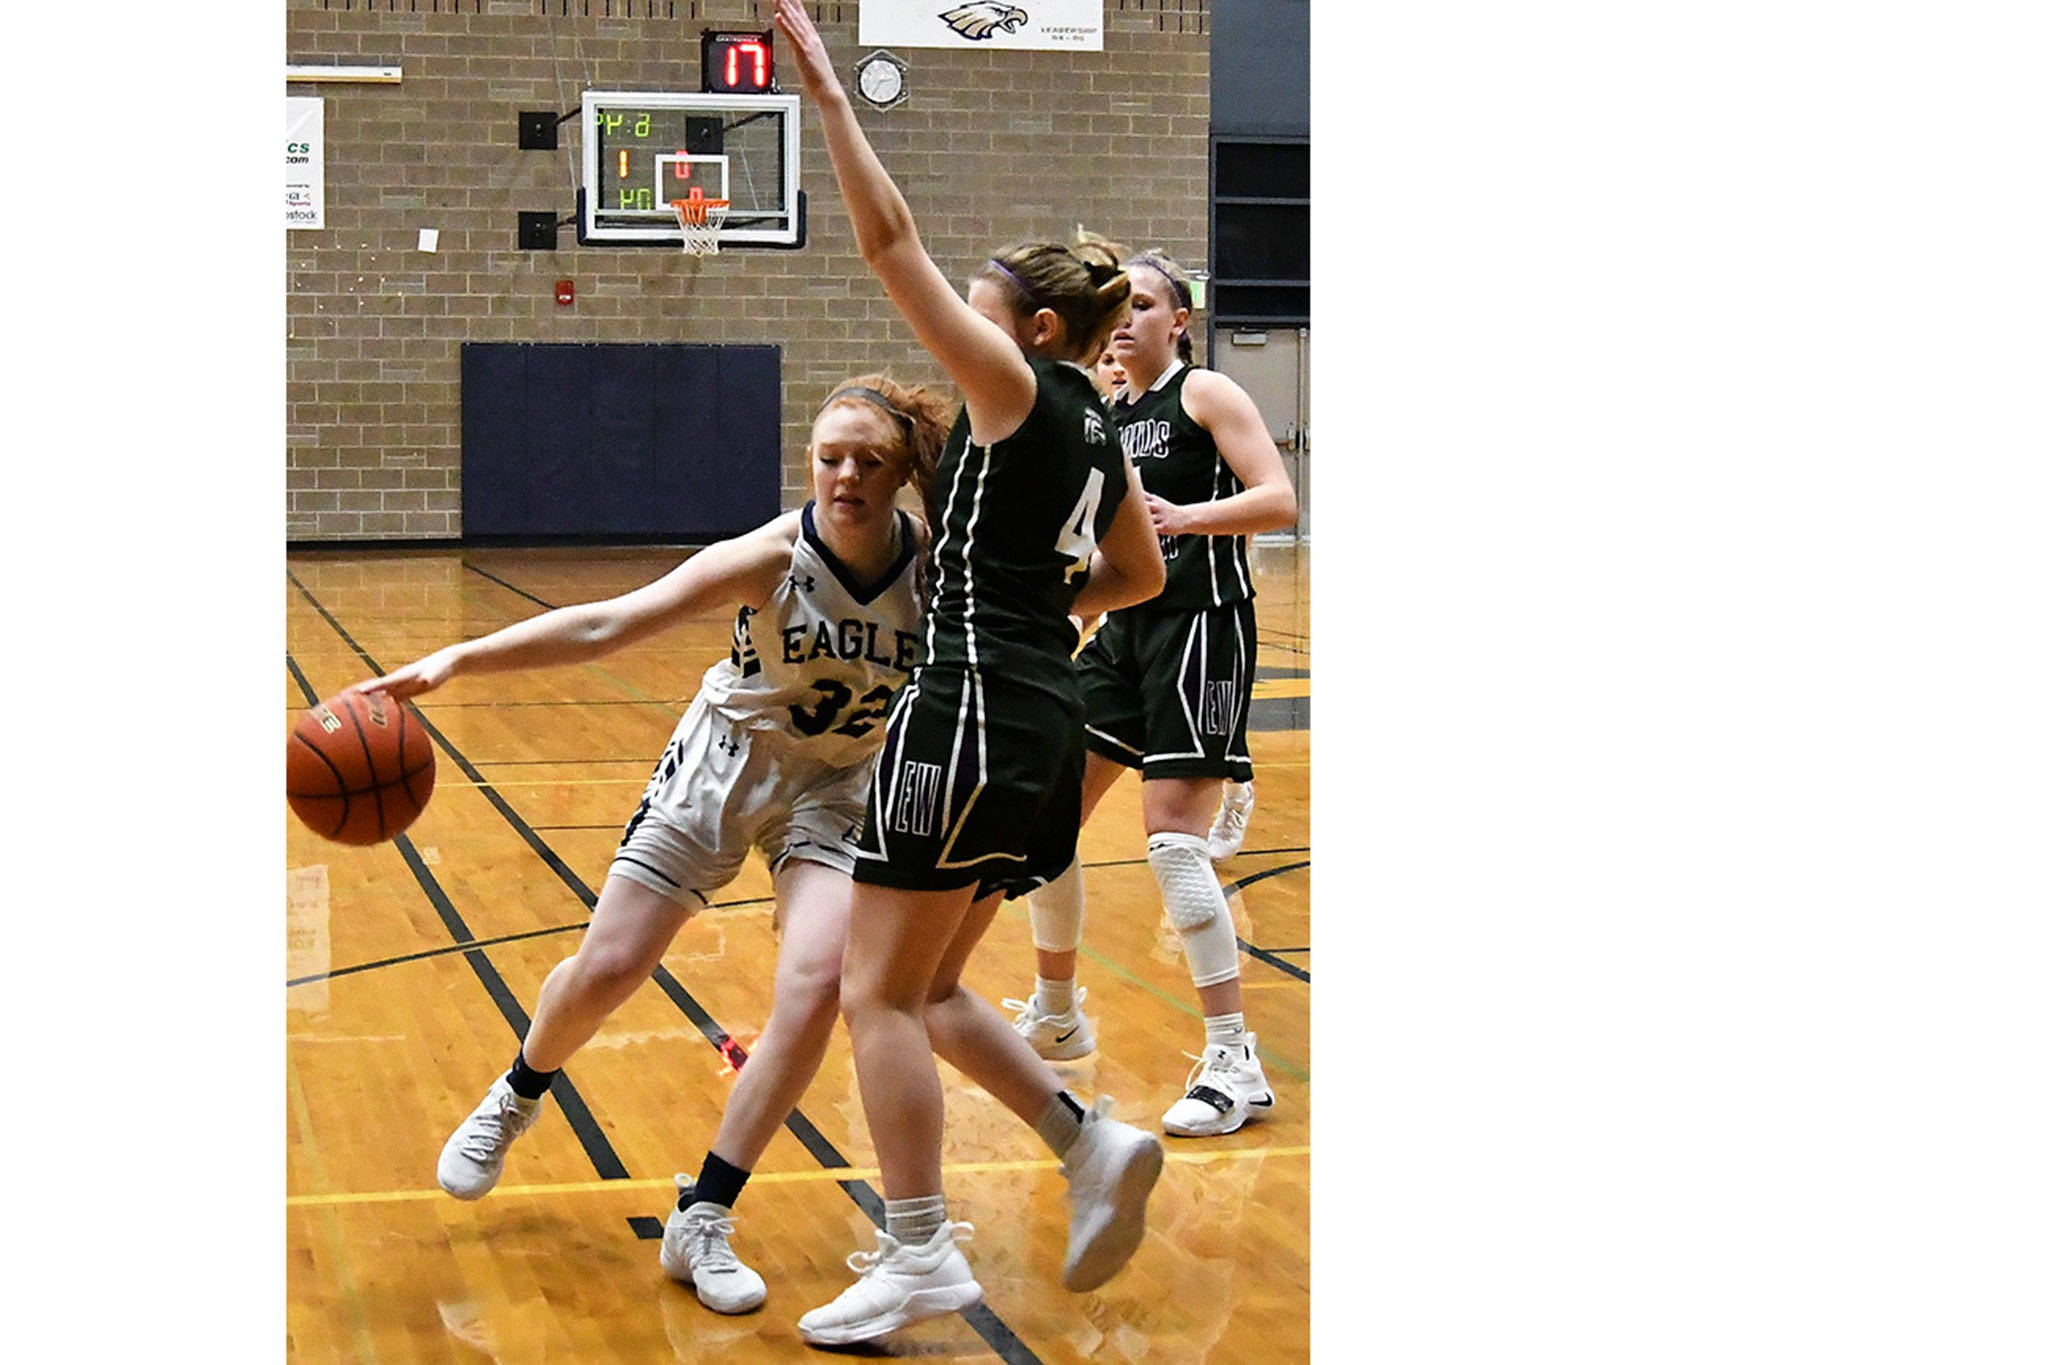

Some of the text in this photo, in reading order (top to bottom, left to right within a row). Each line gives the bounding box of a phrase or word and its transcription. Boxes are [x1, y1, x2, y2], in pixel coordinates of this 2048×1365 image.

[726, 42, 768, 87] 17
[1054, 466, 1105, 585] 4
[789, 679, 894, 739] 32
[1206, 680, 1233, 736] EW
[895, 760, 942, 836] EW
